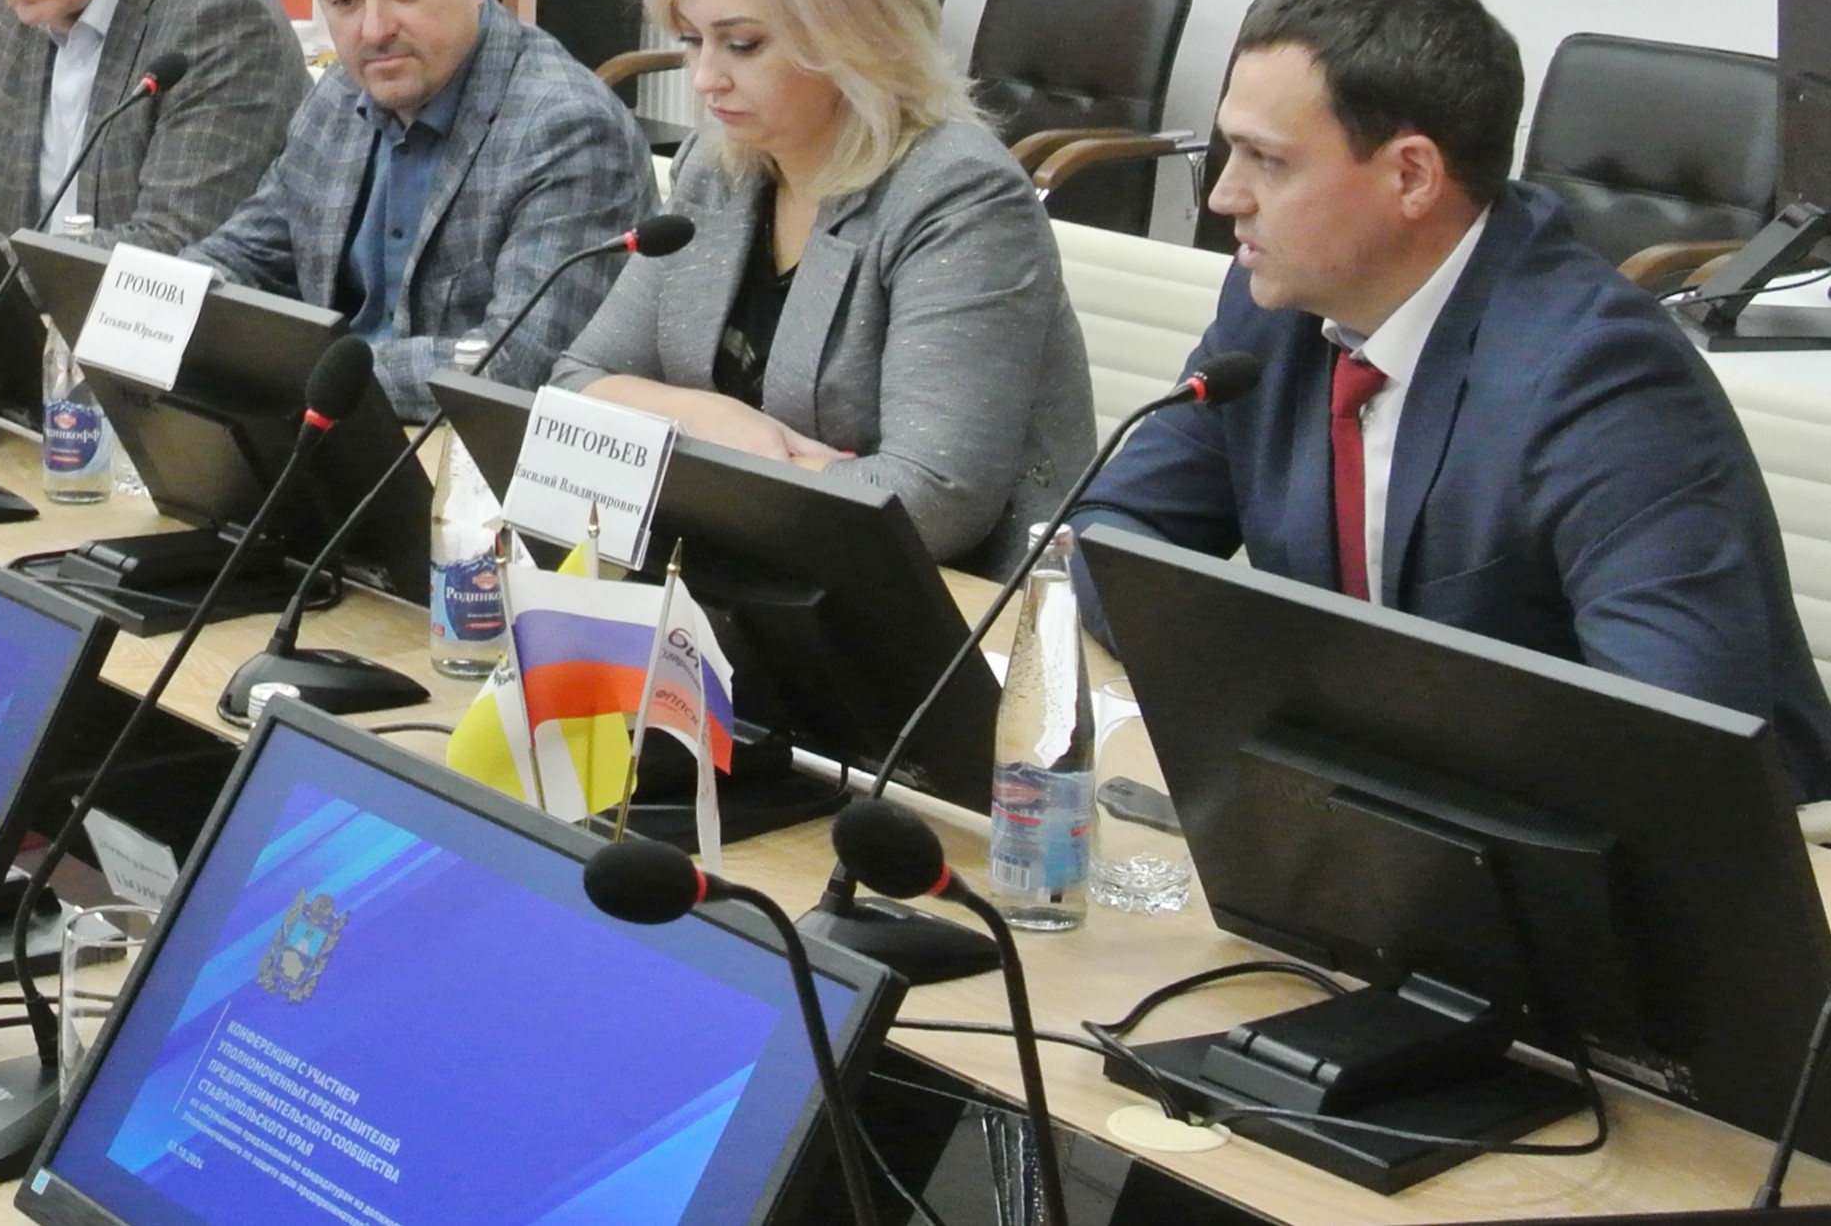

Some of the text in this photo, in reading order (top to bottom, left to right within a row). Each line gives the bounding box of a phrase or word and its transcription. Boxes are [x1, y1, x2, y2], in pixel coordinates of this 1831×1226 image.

[114, 270, 186, 306] ГРОМОВА
[98, 311, 175, 344] Татьяна Юрьевна
[534, 415, 648, 468] ГРИГОРЬЕВ
[559, 476, 643, 516] Владимирович
[445, 586, 503, 603] Роднико
[226, 1019, 360, 1106] КОНФЕРЕНЦИЯ С УЧАСТИЕМ
[197, 1077, 315, 1157] СТАВРОПОЛЬСКОГО КРАЯ
[207, 1058, 401, 1184] ПРЕДПРИНИМАТЕЛЬСКОГО СООБЩЕСТВА
[217, 1039, 401, 1156] УПОЛНОМОЧЕННЫХ ПРЕДСТАВИТЕЛЕЙ
